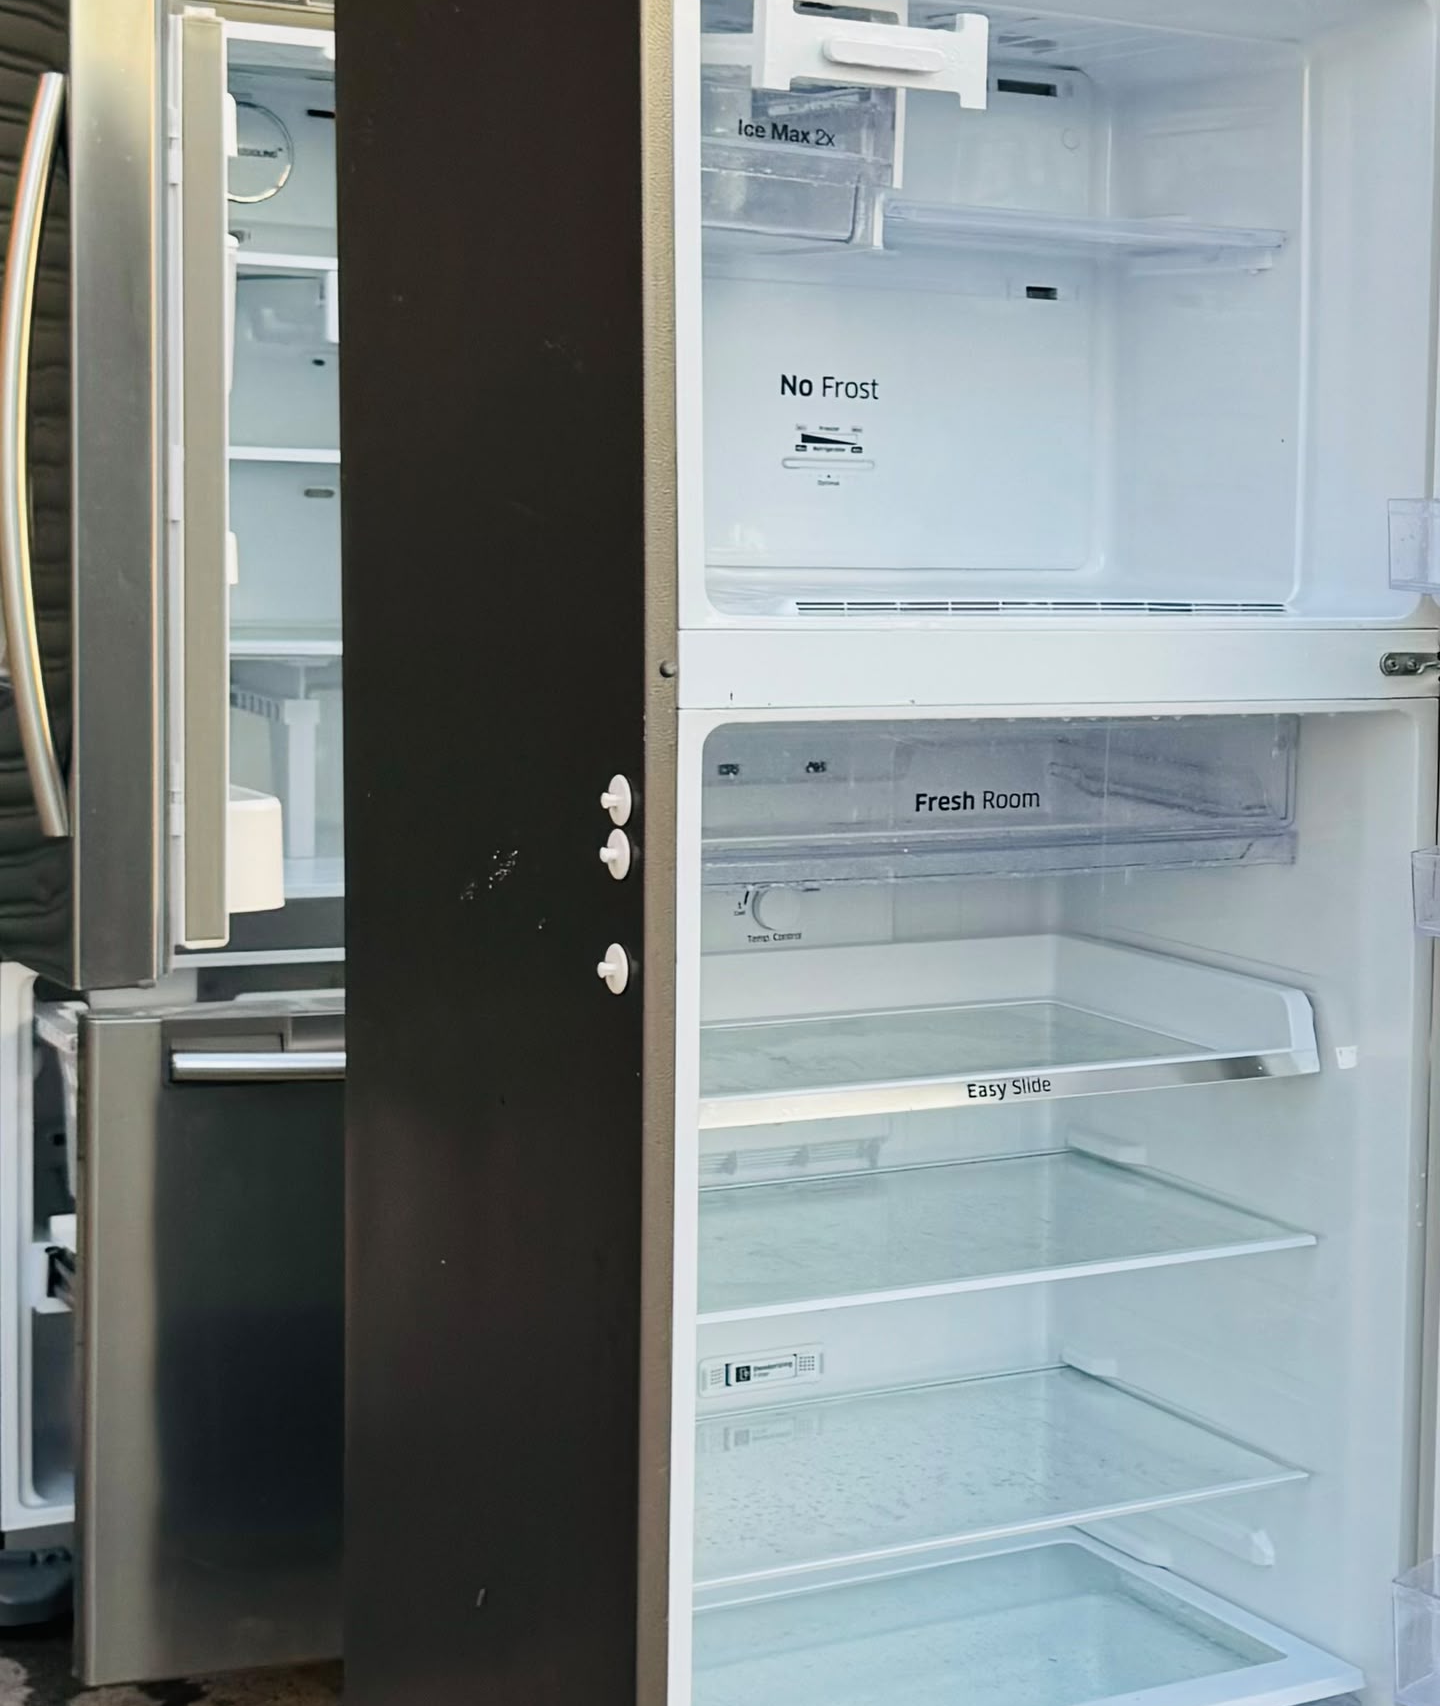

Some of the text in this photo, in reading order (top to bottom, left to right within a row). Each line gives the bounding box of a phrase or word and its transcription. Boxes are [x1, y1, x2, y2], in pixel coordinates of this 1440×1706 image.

[738, 118, 835, 147] Ice Max 2x
[780, 374, 879, 400] No Frost
[915, 790, 1040, 812] Fresh Room
[772, 932, 802, 942] Control
[966, 1077, 1051, 1101] Easy Slide
